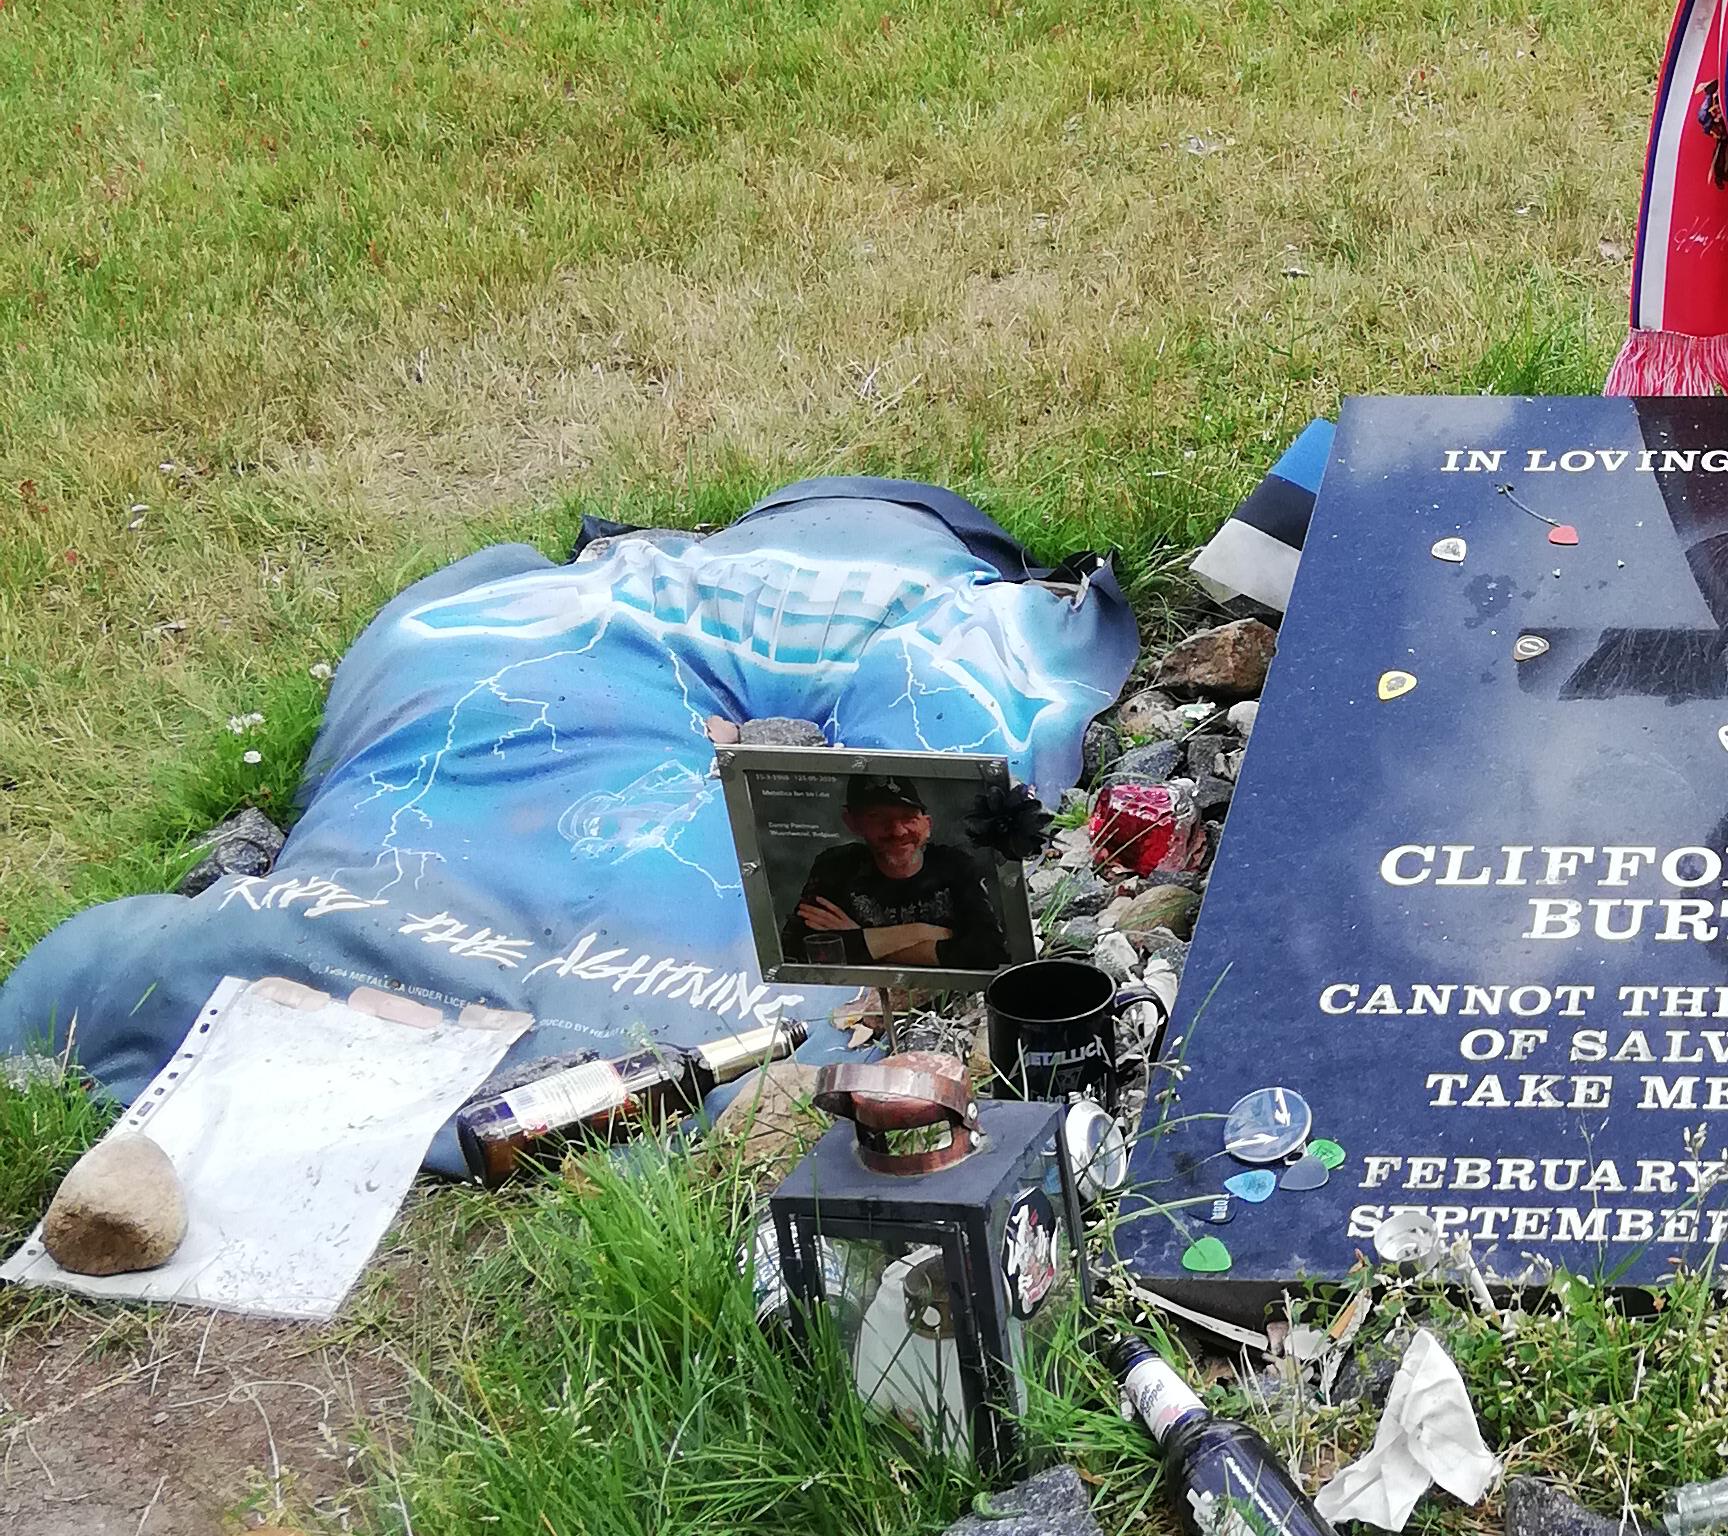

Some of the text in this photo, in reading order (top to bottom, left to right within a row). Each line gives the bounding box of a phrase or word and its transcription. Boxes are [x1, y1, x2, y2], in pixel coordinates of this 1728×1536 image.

[1440, 448, 1507, 474] IN
[1318, 982, 1596, 1016] CANNOT
[1459, 1027, 1552, 1062] OF
[1425, 1073, 1613, 1111] TAKE
